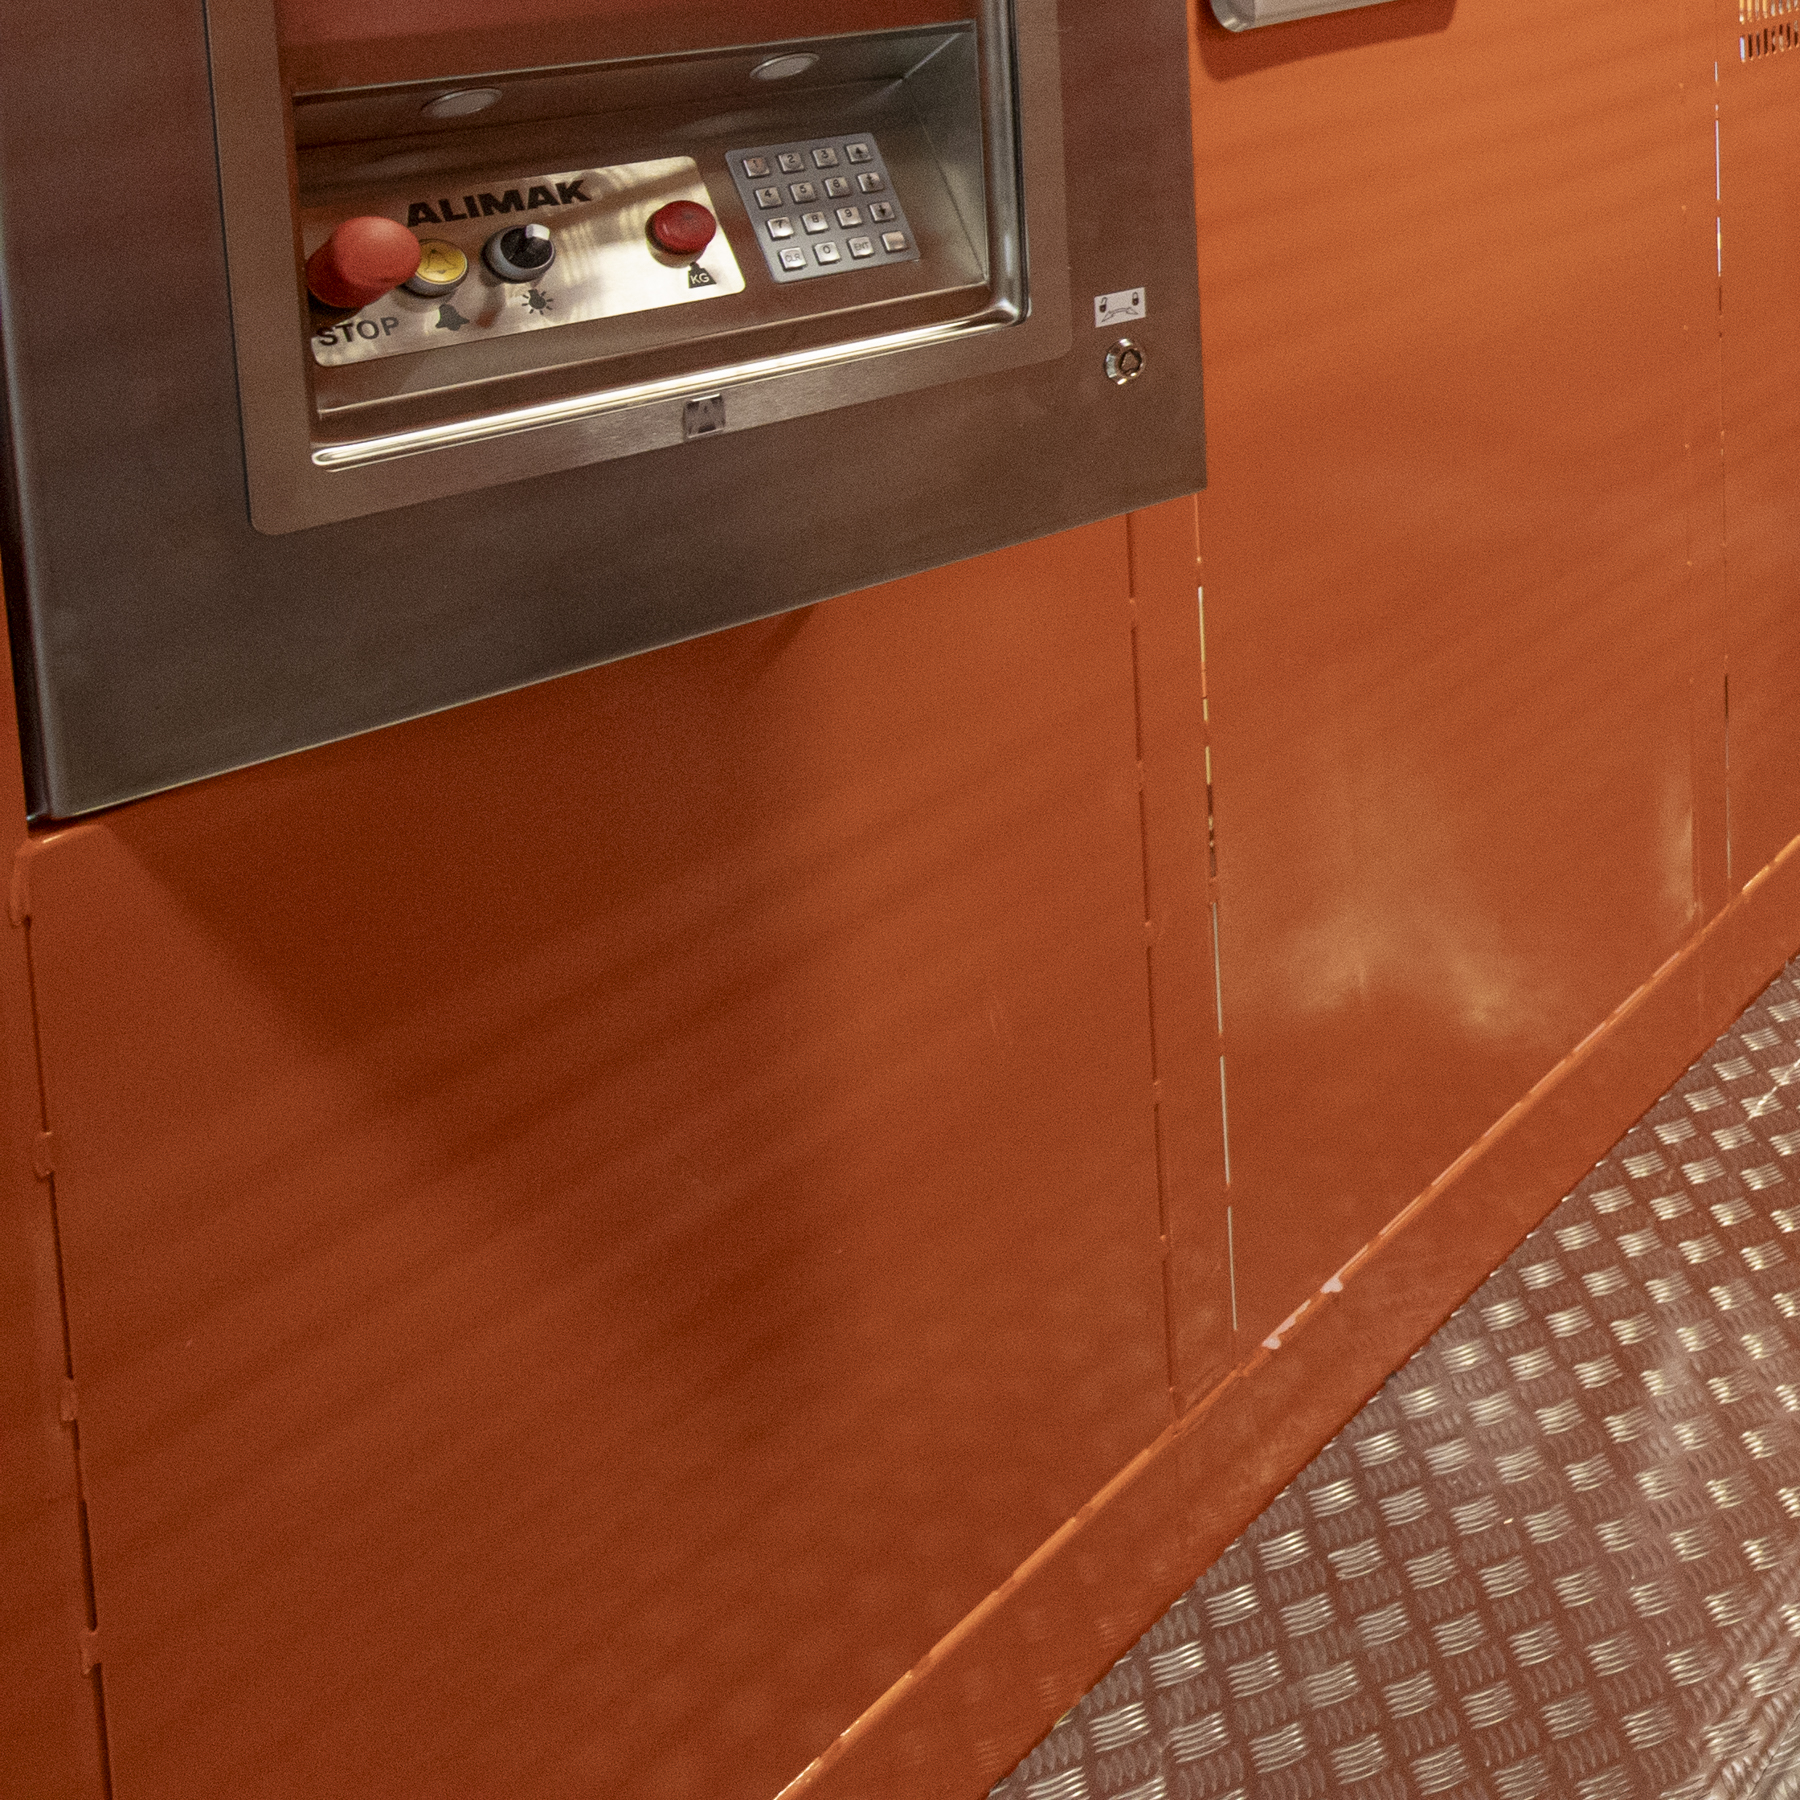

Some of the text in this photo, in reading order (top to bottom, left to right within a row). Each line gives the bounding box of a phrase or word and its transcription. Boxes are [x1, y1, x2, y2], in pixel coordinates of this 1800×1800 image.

[787, 154, 796, 163] 2
[820, 150, 829, 159] 3
[764, 179, 841, 198] 4 5 6
[406, 179, 593, 228] ALIMAK
[776, 208, 853, 229] 7 8 9
[784, 253, 801, 263] CLR
[853, 241, 870, 251] ENT
[690, 273, 710, 284] KG
[315, 315, 400, 347] STOP
